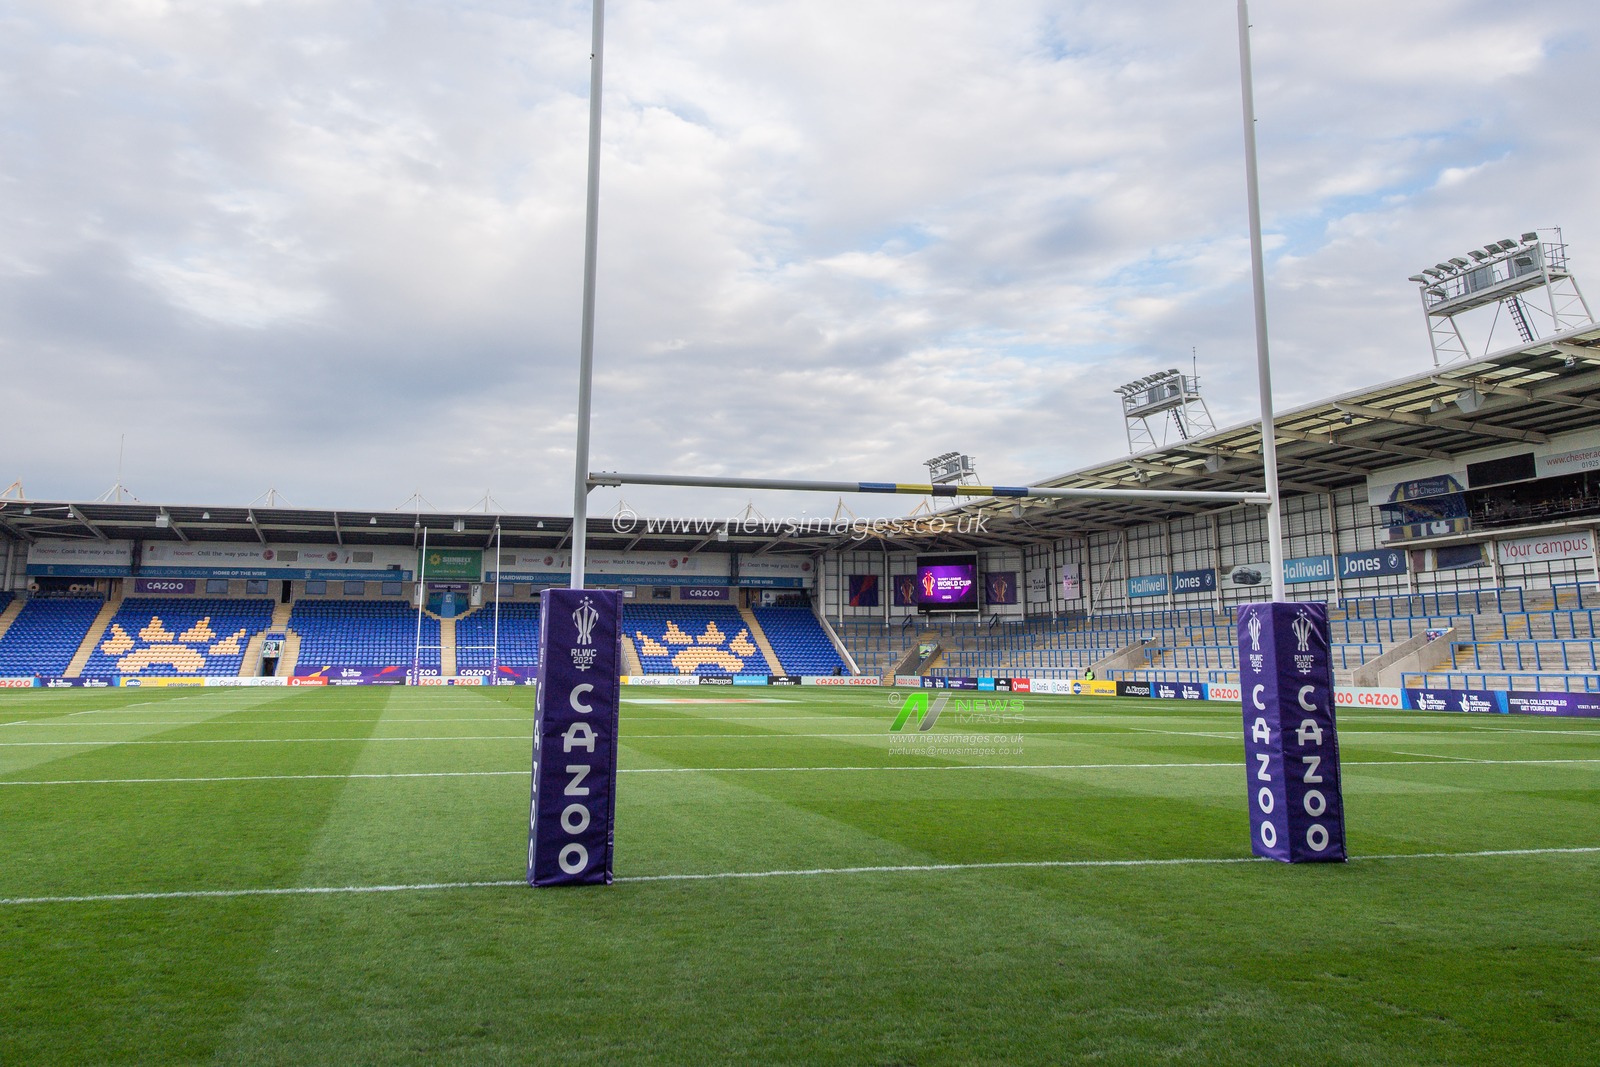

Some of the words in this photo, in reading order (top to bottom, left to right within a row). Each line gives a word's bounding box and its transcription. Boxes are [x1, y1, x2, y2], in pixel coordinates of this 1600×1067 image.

[1420, 486, 1444, 495] Chester
[1502, 542, 1531, 558] Your
[1535, 537, 1588, 556] campus
[1283, 559, 1330, 579] Halliwell
[1344, 556, 1380, 575] Jones
[1132, 578, 1166, 593] Halliwell
[1175, 575, 1200, 590] Jones
[570, 648, 597, 657] RLWC
[1132, 686, 1149, 695] Kappa
[1210, 688, 1239, 699] CAZOO
[1358, 693, 1398, 706] CAZOO
[1251, 684, 1277, 848] CAZOO
[1295, 685, 1329, 852] CAZOO
[558, 684, 598, 874] CAZOO
